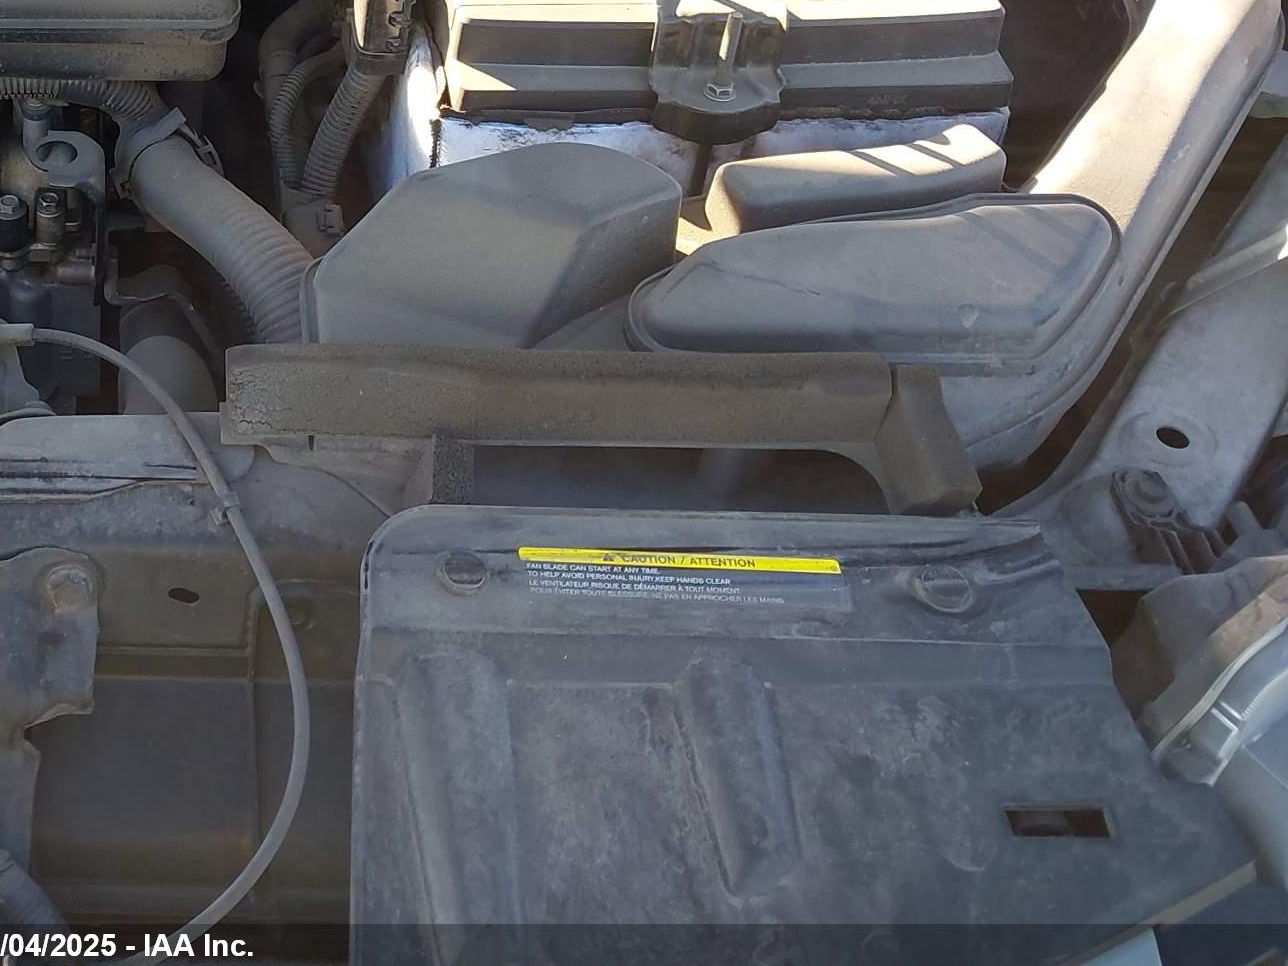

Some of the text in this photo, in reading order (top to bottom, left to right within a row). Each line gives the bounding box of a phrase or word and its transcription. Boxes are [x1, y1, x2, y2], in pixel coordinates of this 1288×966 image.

[623, 553, 676, 564] CAUTION
[690, 557, 756, 568] ATTENTION
[543, 563, 568, 571] BLADE
[570, 564, 586, 572] CAN
[588, 565, 611, 573] START
[587, 573, 627, 581] PERSONAL
[677, 577, 704, 585] HANDS
[540, 580, 588, 588] VENTILATEUR
[591, 582, 619, 590] RISQUE
[685, 585, 705, 593] TOUT
